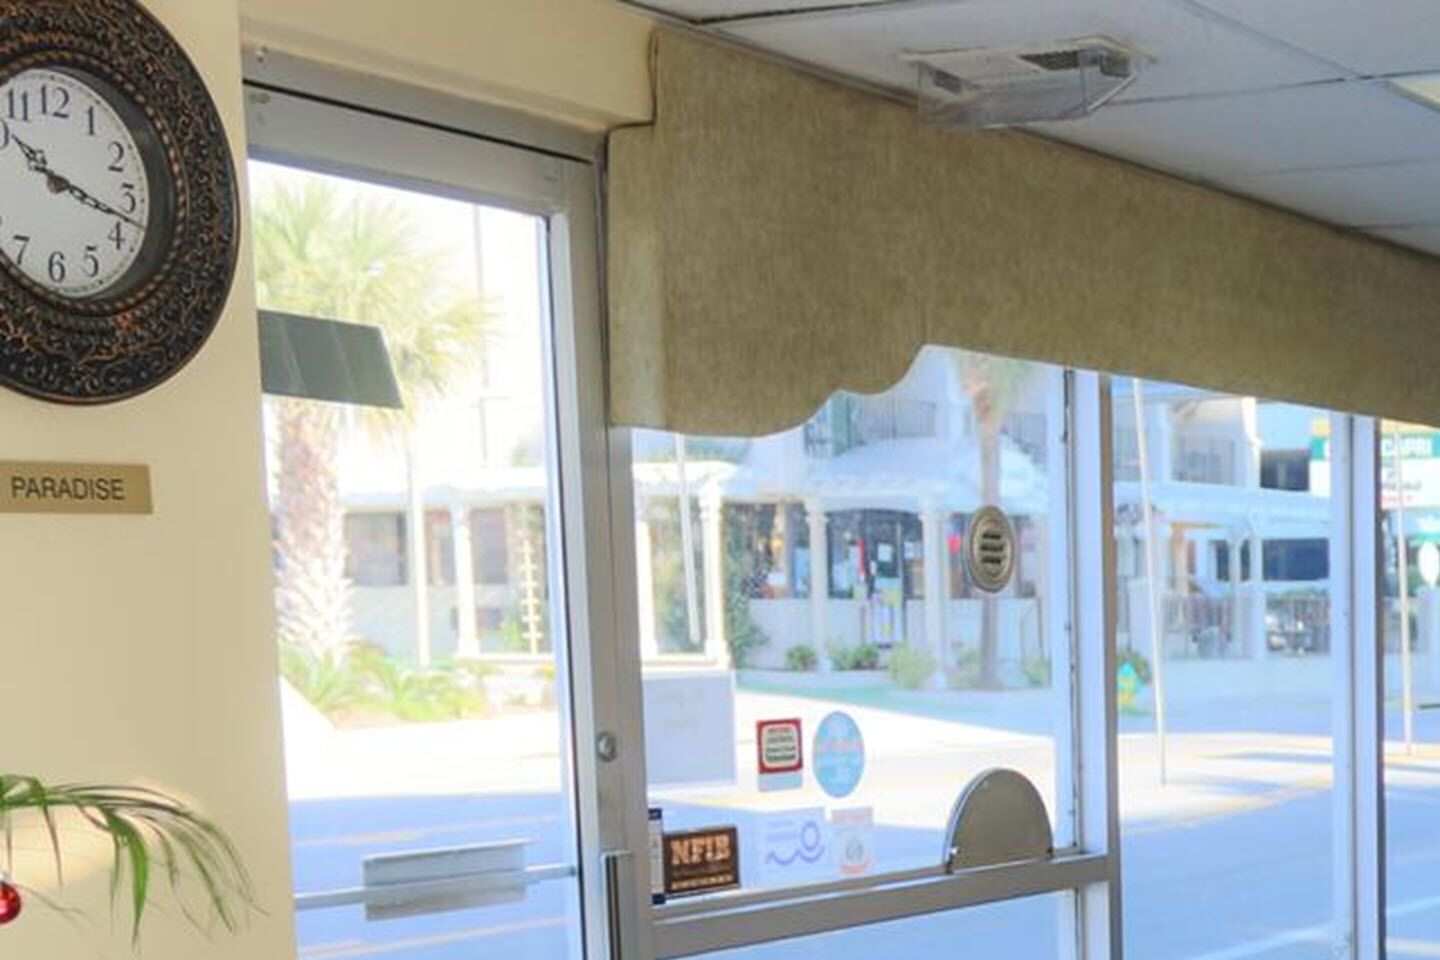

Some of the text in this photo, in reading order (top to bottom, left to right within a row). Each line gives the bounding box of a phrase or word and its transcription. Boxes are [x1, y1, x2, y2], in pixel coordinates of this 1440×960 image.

[7, 88, 29, 122] 11
[41, 84, 70, 119] 12
[87, 105, 95, 136] 1
[107, 141, 125, 173] 2
[120, 182, 136, 215] 3
[13, 234, 30, 265] 7
[107, 220, 125, 251] 4
[48, 250, 66, 283] 6
[82, 245, 99, 278] 5
[10, 475, 126, 501] PARADISE
